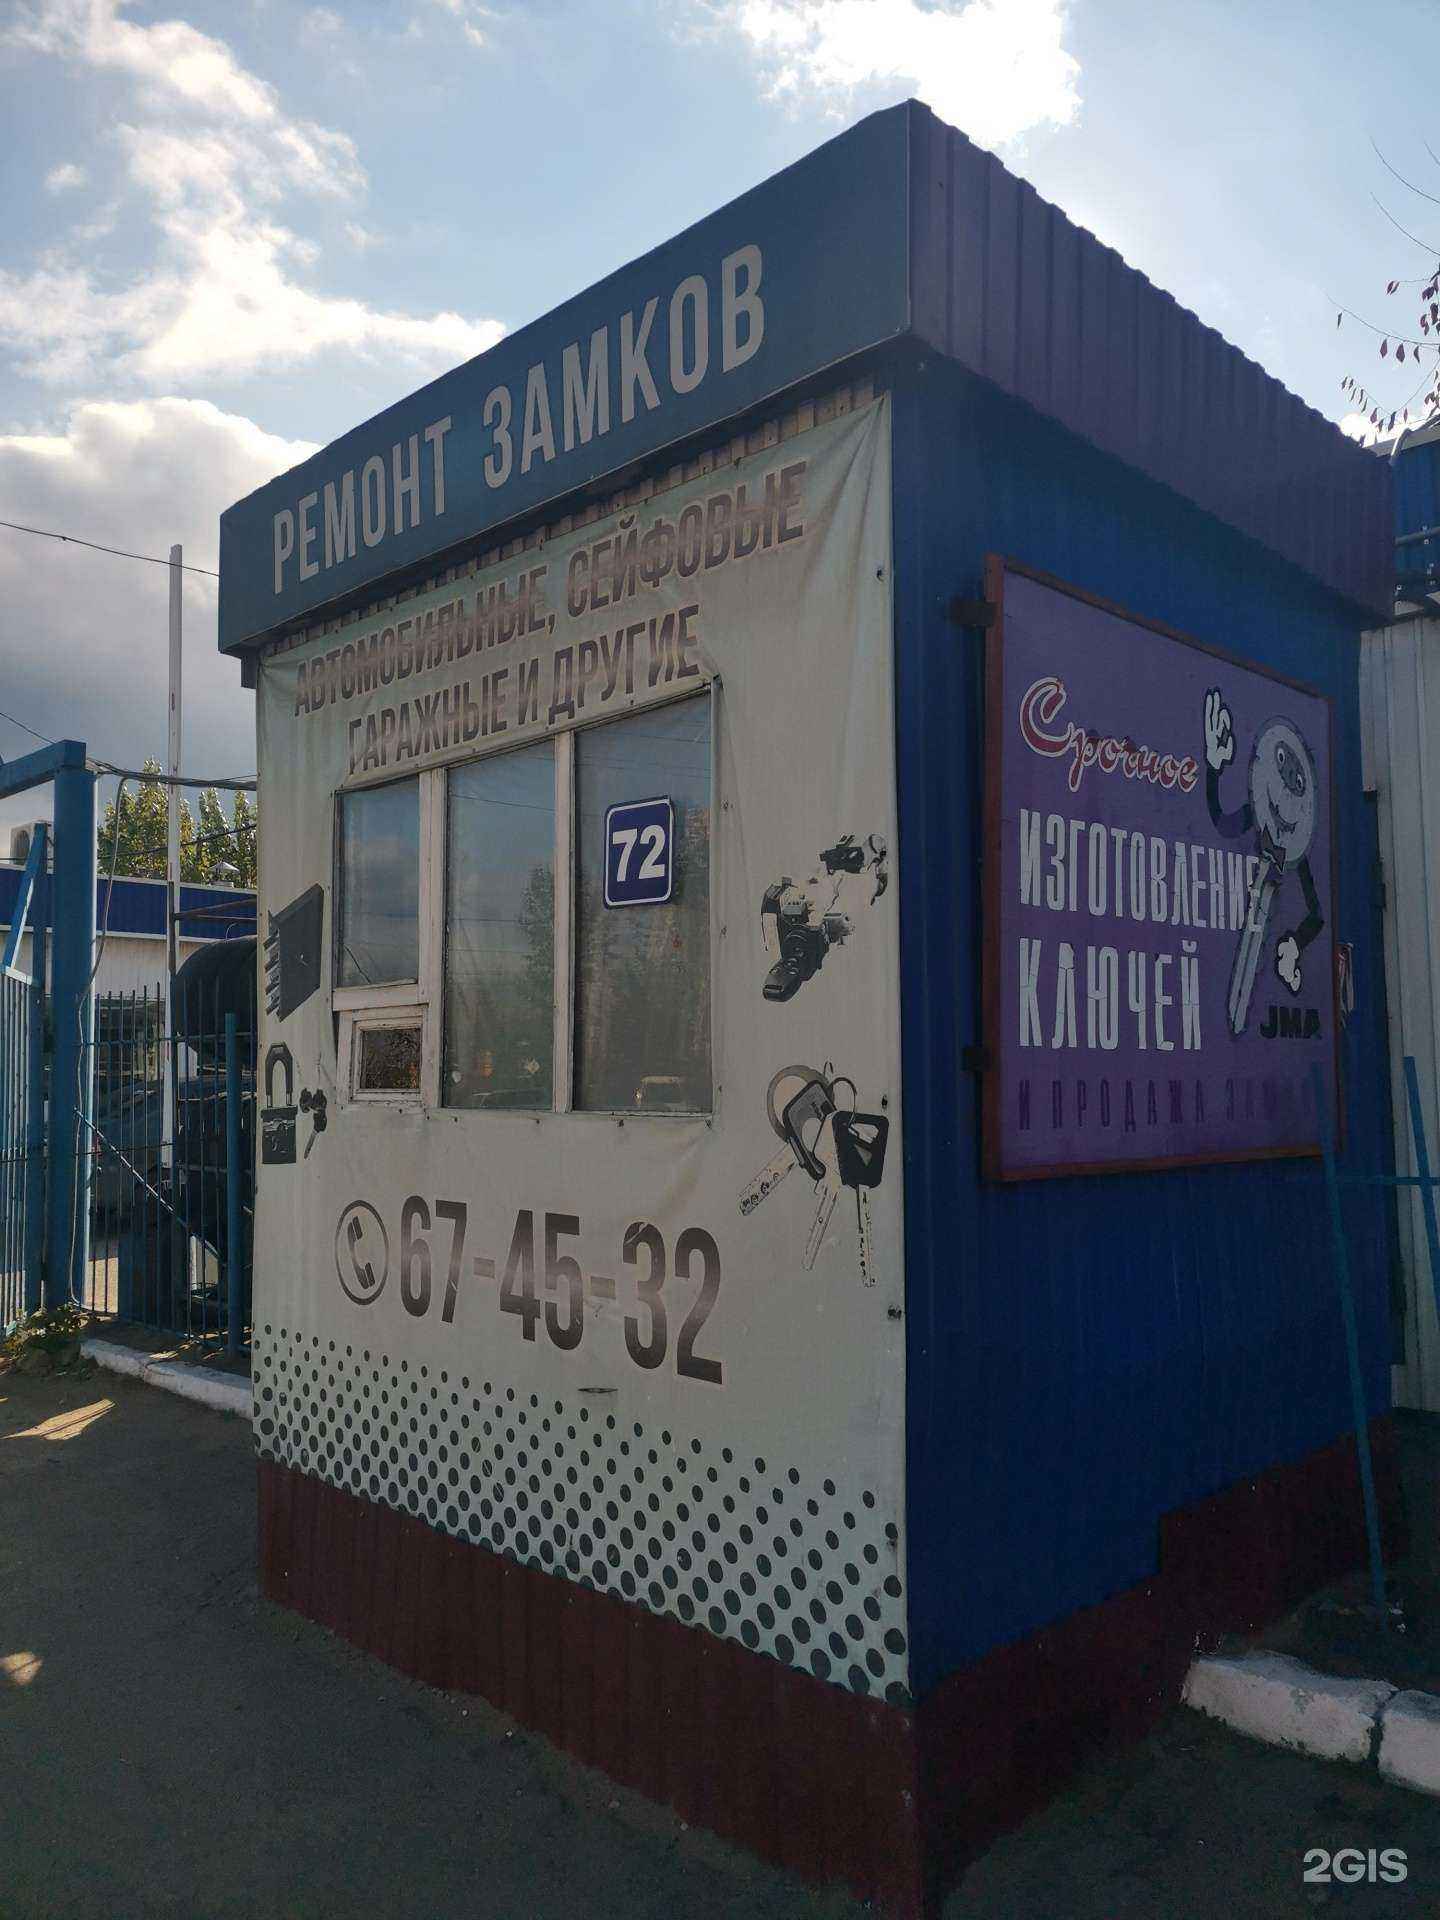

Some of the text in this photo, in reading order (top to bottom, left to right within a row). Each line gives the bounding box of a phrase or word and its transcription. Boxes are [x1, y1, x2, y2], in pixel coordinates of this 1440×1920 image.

[274, 244, 765, 595] РЕМОНТ ЗАМКОВ
[294, 460, 807, 717] АВТОМОБИЛЬНЫЕ, СЕЙФОВЫЕ
[347, 605, 700, 775] ГАРАЖНЫЕ И ДРУГИЕ
[1020, 677, 1199, 792] Срочное
[612, 825, 667, 883] 72
[1019, 808, 1264, 933] ИЗГОТОВЛЕНИЕ
[1019, 937, 1202, 1050] КЛЮЧЕЙ
[1259, 1007, 1321, 1040] JMA
[1052, 1077, 1204, 1132] ПРОДАЖА
[400, 1194, 722, 1385] 67-45-32
